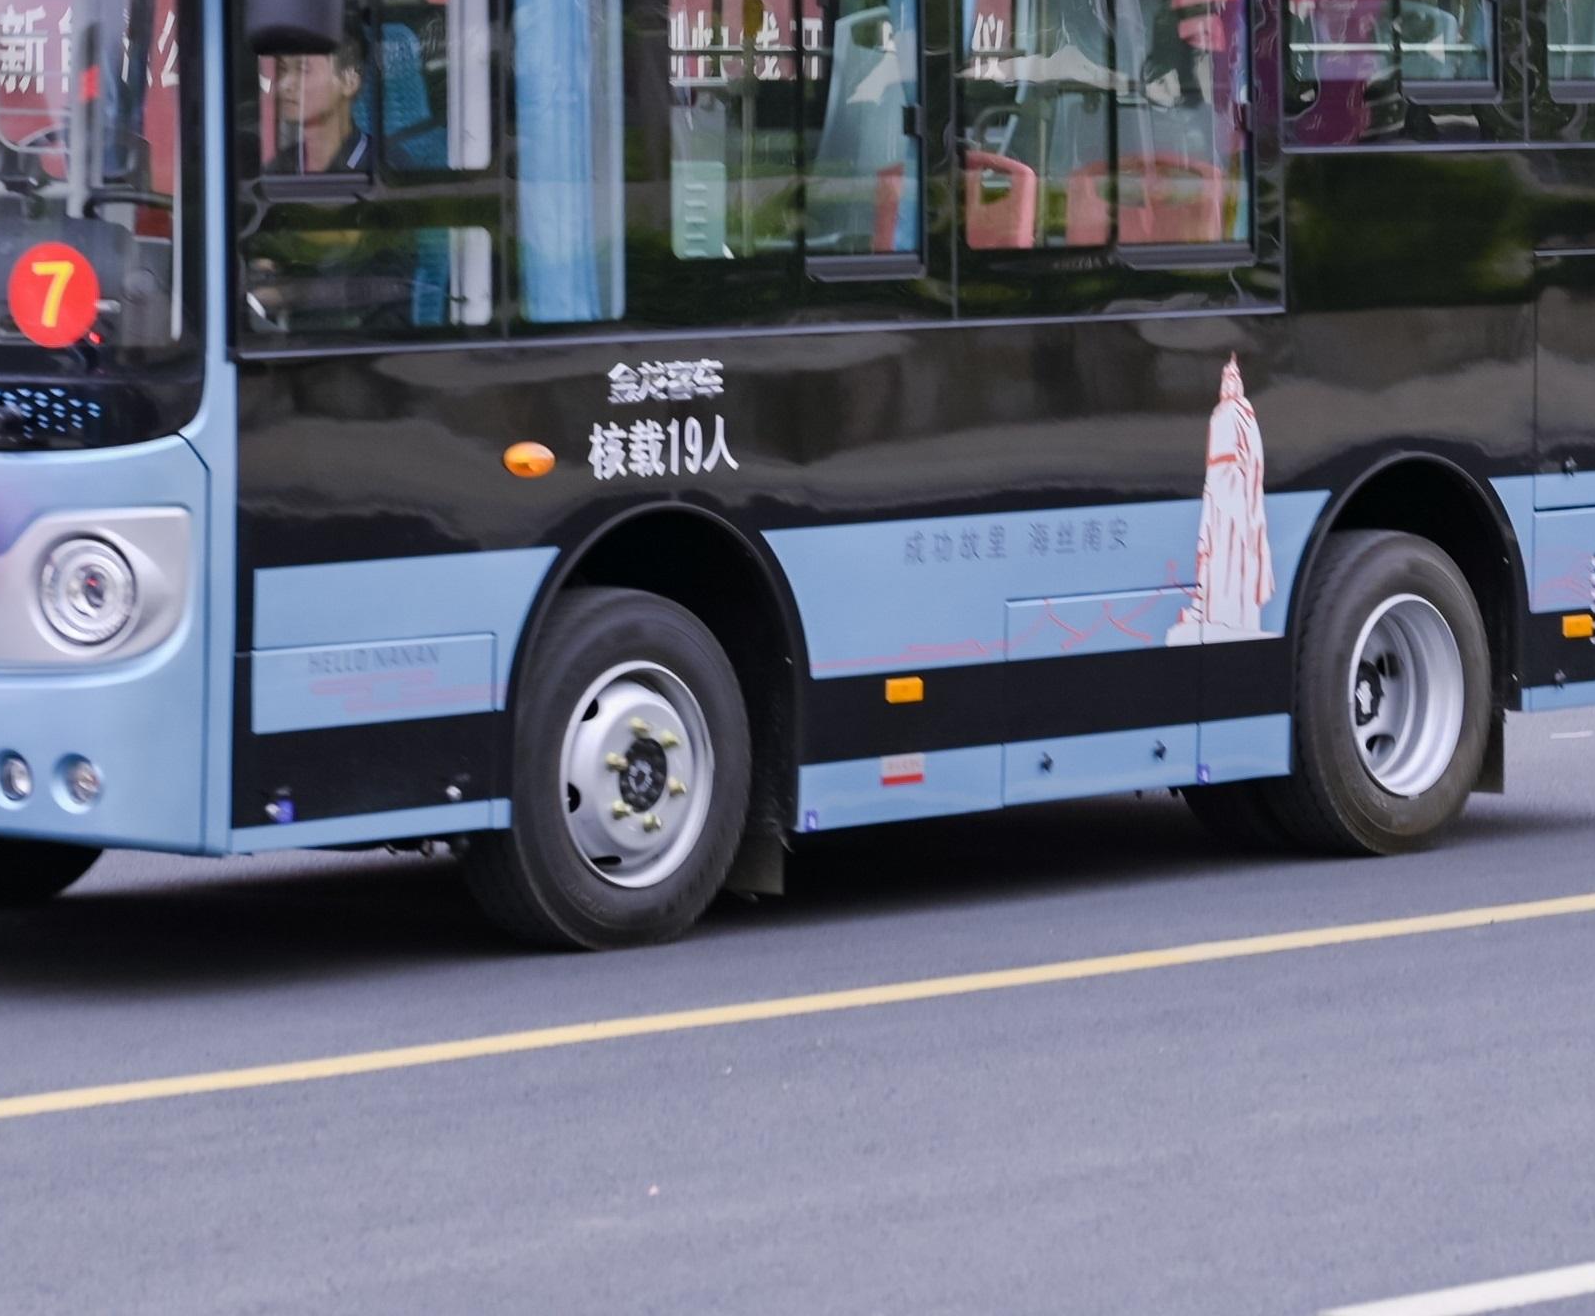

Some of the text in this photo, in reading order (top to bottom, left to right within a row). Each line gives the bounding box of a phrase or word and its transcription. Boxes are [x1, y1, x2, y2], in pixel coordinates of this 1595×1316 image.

[31, 260, 75, 327] 7
[607, 358, 724, 403] 金龙客车
[588, 414, 739, 480] 核载19人
